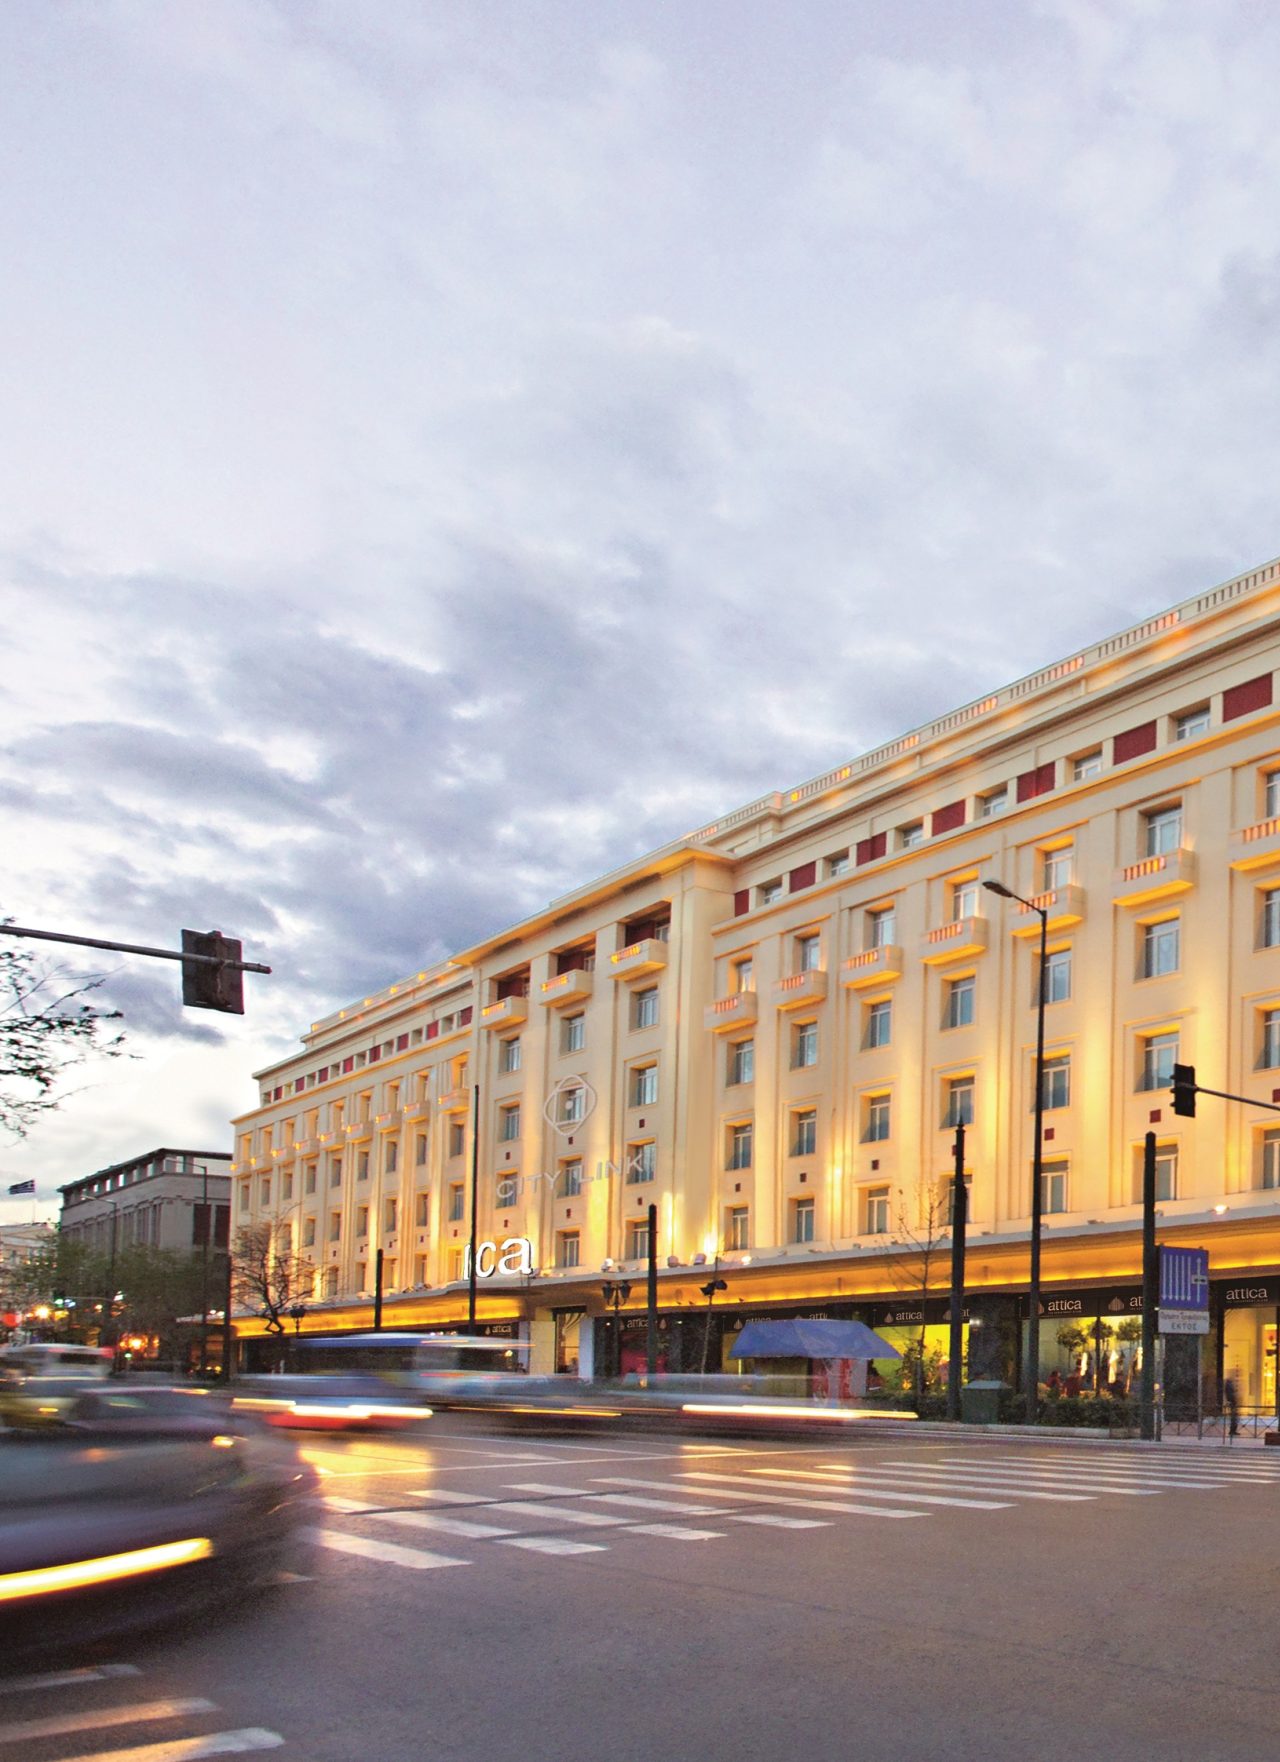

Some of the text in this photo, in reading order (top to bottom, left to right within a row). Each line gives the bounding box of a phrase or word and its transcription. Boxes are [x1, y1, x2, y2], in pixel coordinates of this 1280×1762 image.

[496, 1153, 643, 1199] CITY LINK
[1225, 1287, 1268, 1300] attica
[1048, 1299, 1082, 1312] attica
[895, 1311, 923, 1321] attica
